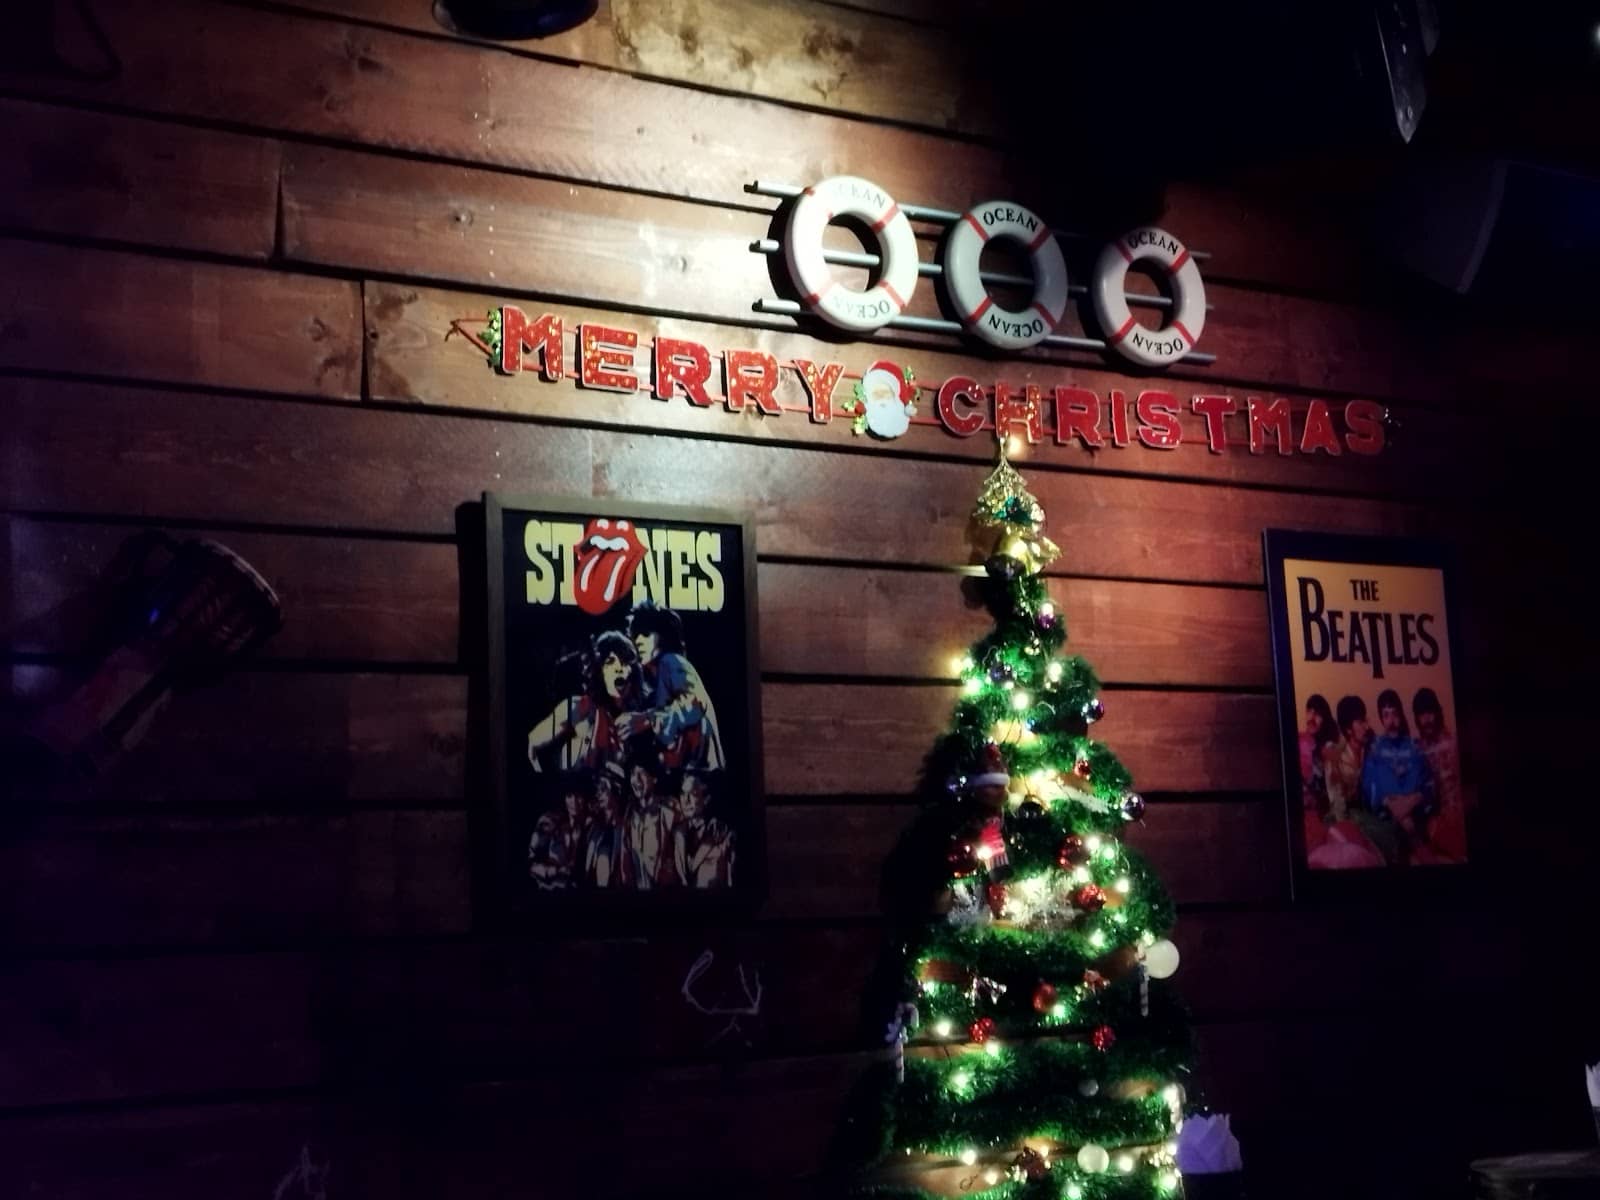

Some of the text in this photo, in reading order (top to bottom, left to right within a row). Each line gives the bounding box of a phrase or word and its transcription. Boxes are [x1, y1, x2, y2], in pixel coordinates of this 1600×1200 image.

[982, 207, 1039, 233] OCEAN
[1127, 231, 1179, 255] OCEAN
[988, 313, 1044, 338] OCEAN
[1132, 331, 1183, 356] OCEAN
[502, 304, 1386, 457] MERRY CHRISTMAS
[524, 519, 725, 613] STNES
[1349, 578, 1381, 602] THE
[1296, 576, 1440, 679] BEATLES
